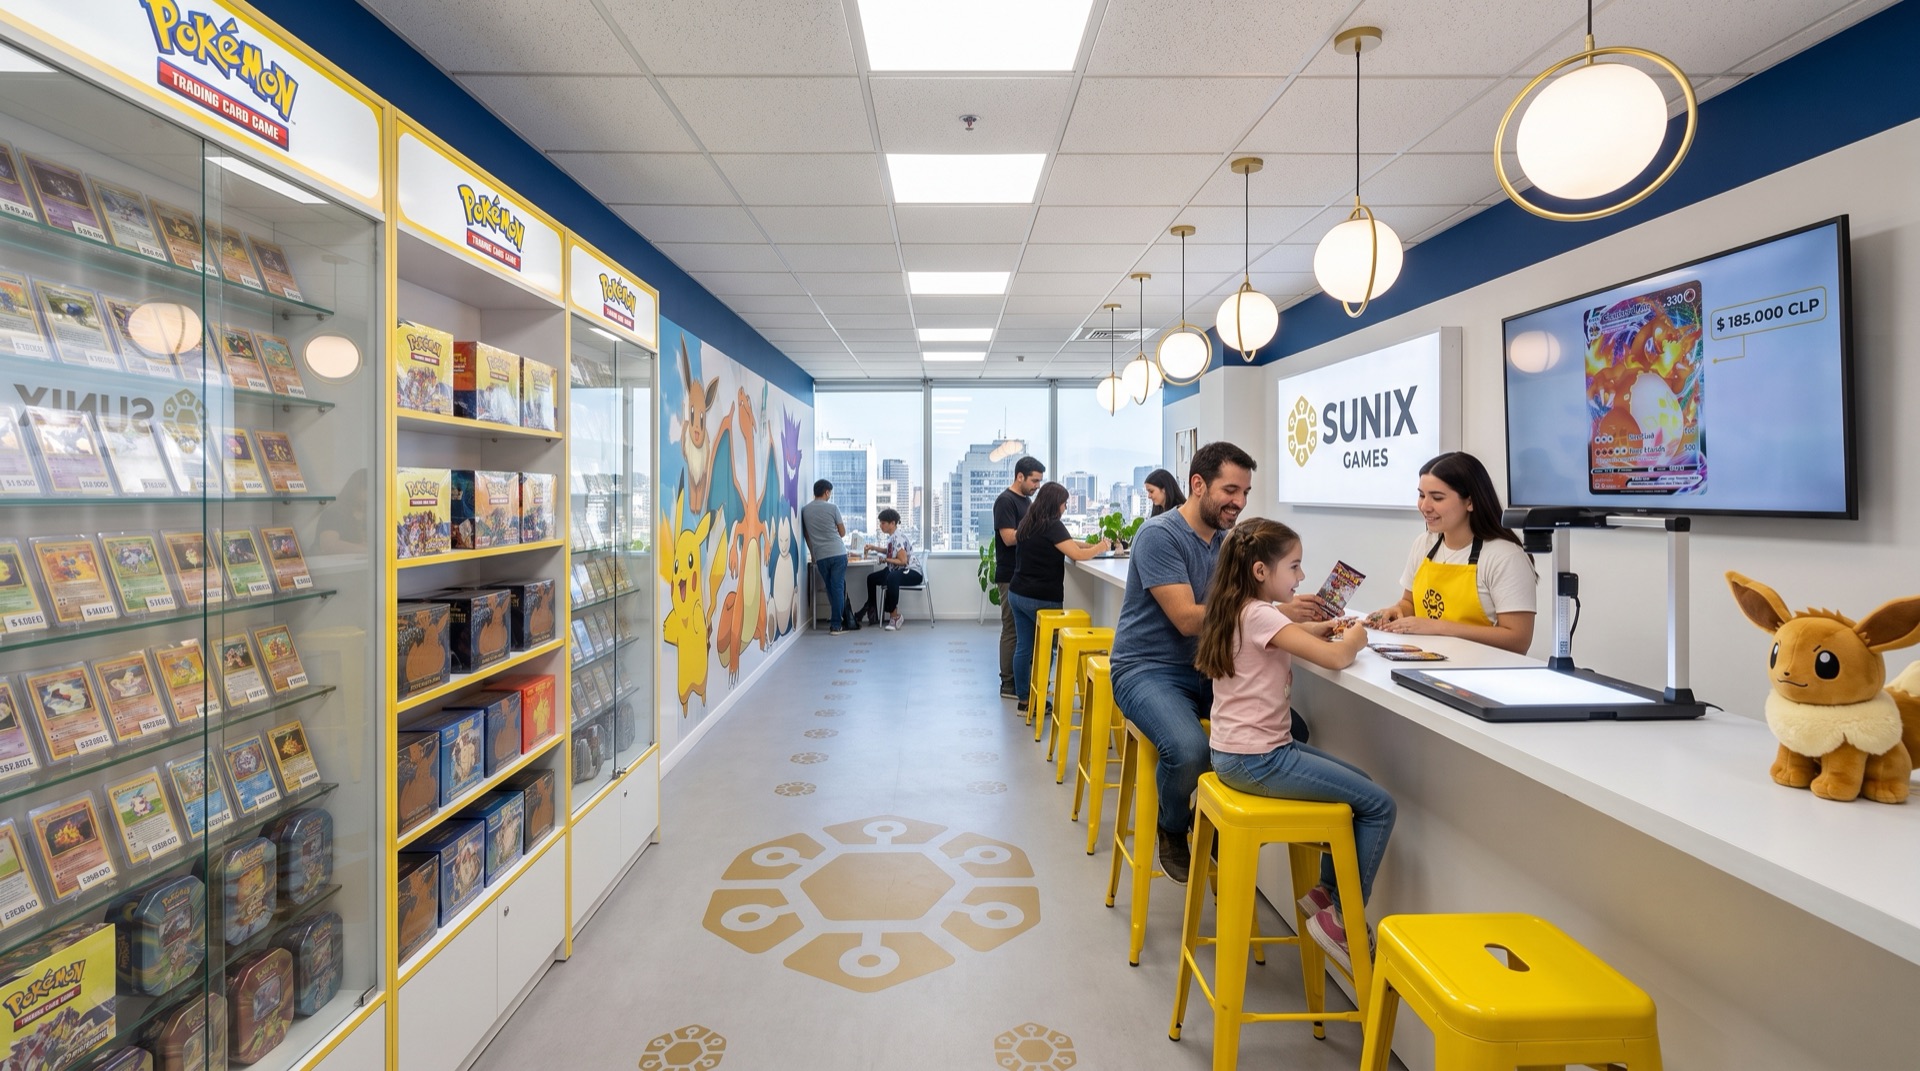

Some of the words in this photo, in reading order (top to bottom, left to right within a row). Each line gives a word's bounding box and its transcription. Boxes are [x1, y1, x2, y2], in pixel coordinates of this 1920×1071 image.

[172, 71, 219, 107] TRADING
[222, 95, 249, 123] CARD
[1717, 317, 1725, 332] $
[1728, 306, 1783, 328] 185.000
[1788, 298, 1819, 316] CLP
[1322, 385, 1418, 444] SUNIX
[1343, 448, 1389, 469] GAMES
